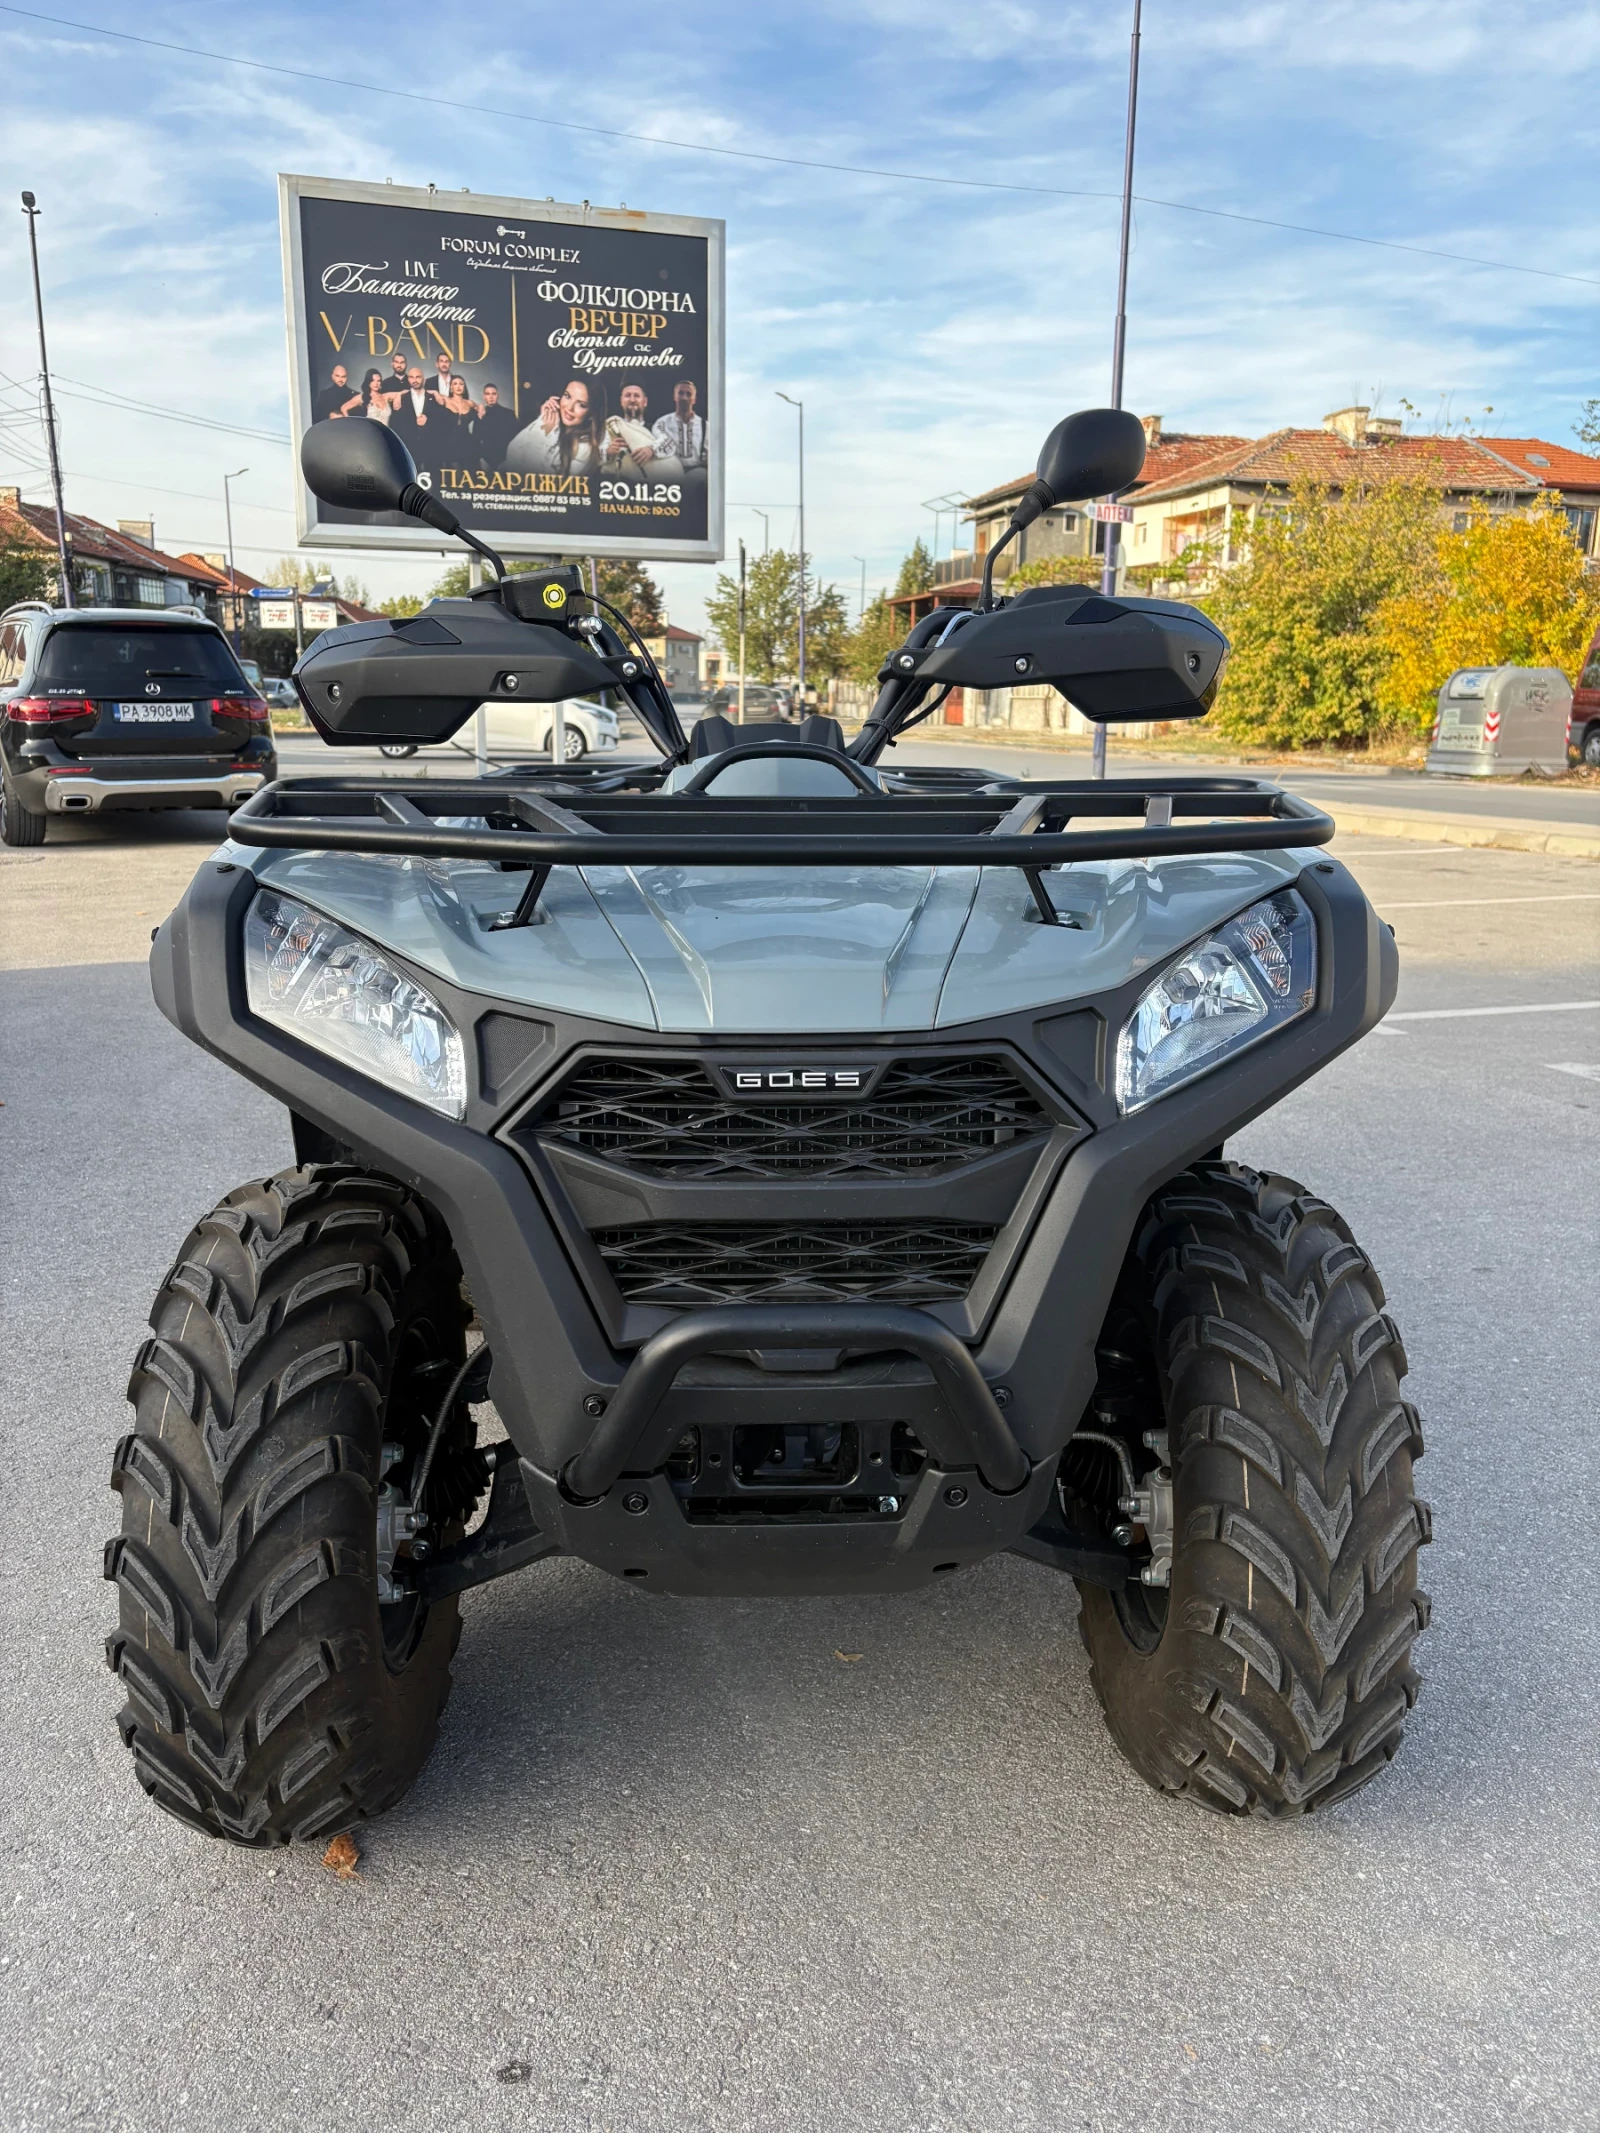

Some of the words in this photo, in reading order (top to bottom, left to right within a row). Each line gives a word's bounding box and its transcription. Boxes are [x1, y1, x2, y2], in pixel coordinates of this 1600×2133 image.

[441, 236, 500, 256] FORUM
[504, 243, 581, 264] COMPLEX
[321, 261, 459, 301] Балканско
[405, 260, 440, 280] LIVE
[537, 280, 697, 314] ФОЛКЛОРНА
[400, 301, 476, 329] парти
[568, 307, 667, 339] ВЕЧЕР
[319, 311, 490, 364] V-BAND
[548, 328, 627, 348] Светла
[572, 347, 685, 376] Дукатева
[440, 469, 590, 495] ПАЗАРДЖИК
[440, 490, 460, 500] Тел.
[461, 492, 472, 500] за
[599, 481, 682, 503] 20.11.26
[600, 503, 651, 515] НАЧАЛО:
[142, 704, 173, 718] 3908
[736, 1072, 860, 1088] GOES
